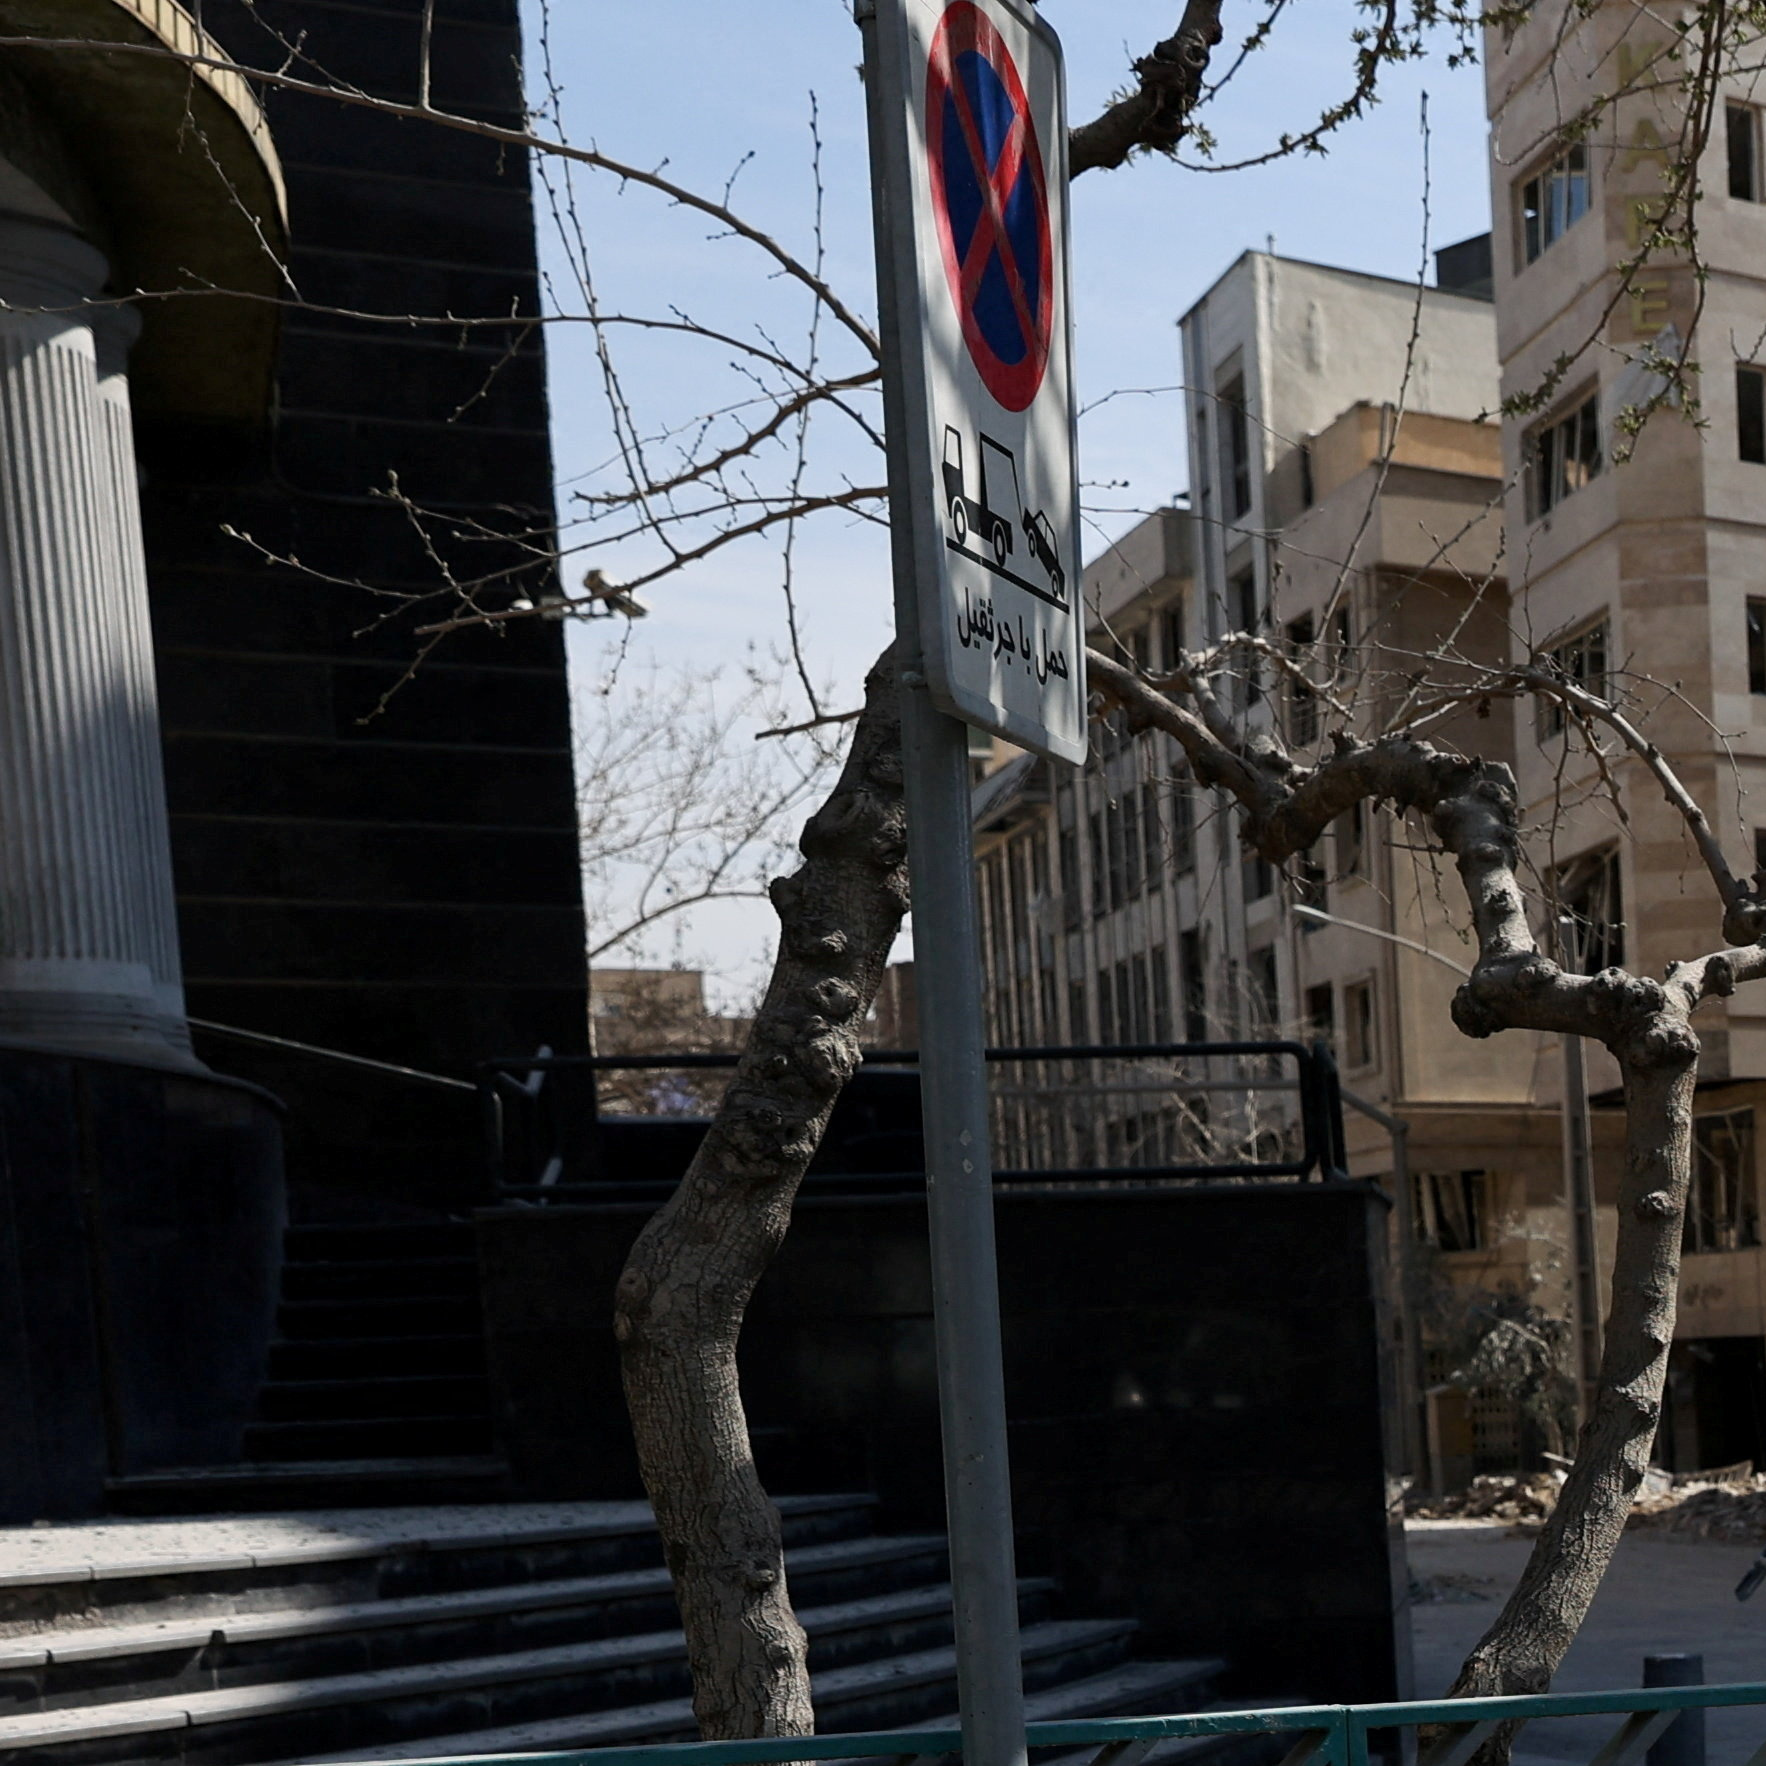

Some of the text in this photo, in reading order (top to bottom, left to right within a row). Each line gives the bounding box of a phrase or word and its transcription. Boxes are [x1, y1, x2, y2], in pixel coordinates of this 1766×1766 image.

[957, 586, 1069, 686] حمل با جرثقیل
